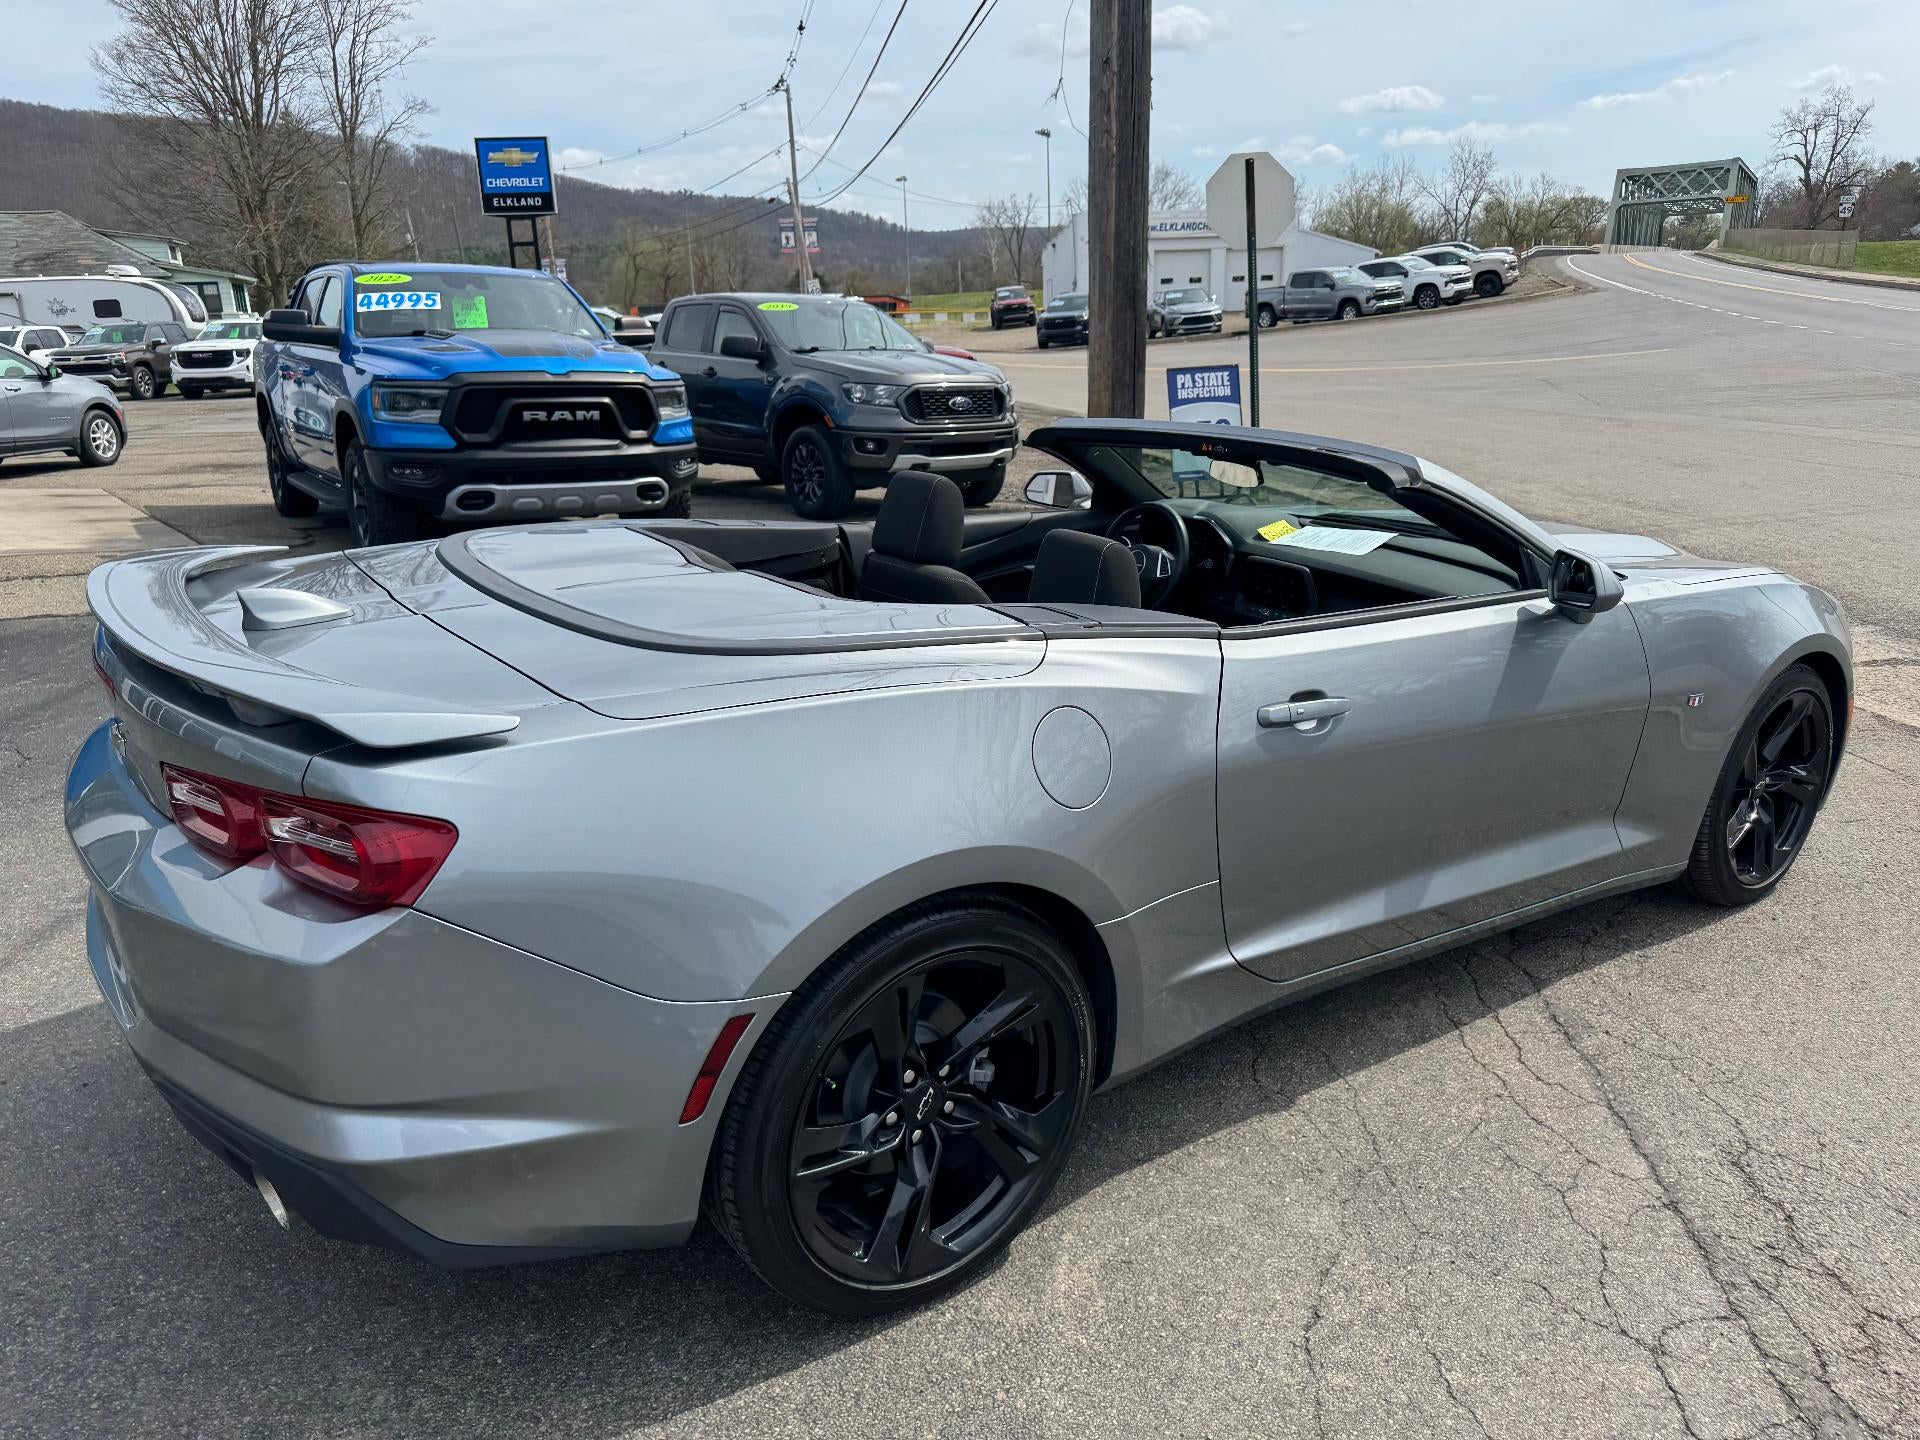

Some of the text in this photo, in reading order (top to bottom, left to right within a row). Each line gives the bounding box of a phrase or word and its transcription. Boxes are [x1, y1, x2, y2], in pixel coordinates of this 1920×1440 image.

[486, 177, 544, 188] CHEVROLET
[493, 197, 542, 207] ELKLAND
[1840, 206, 1853, 215] 49
[358, 293, 438, 310] 44995
[1176, 371, 1230, 389] PA STATE
[1177, 385, 1231, 399] INSPECTION
[522, 410, 601, 421] RAM
